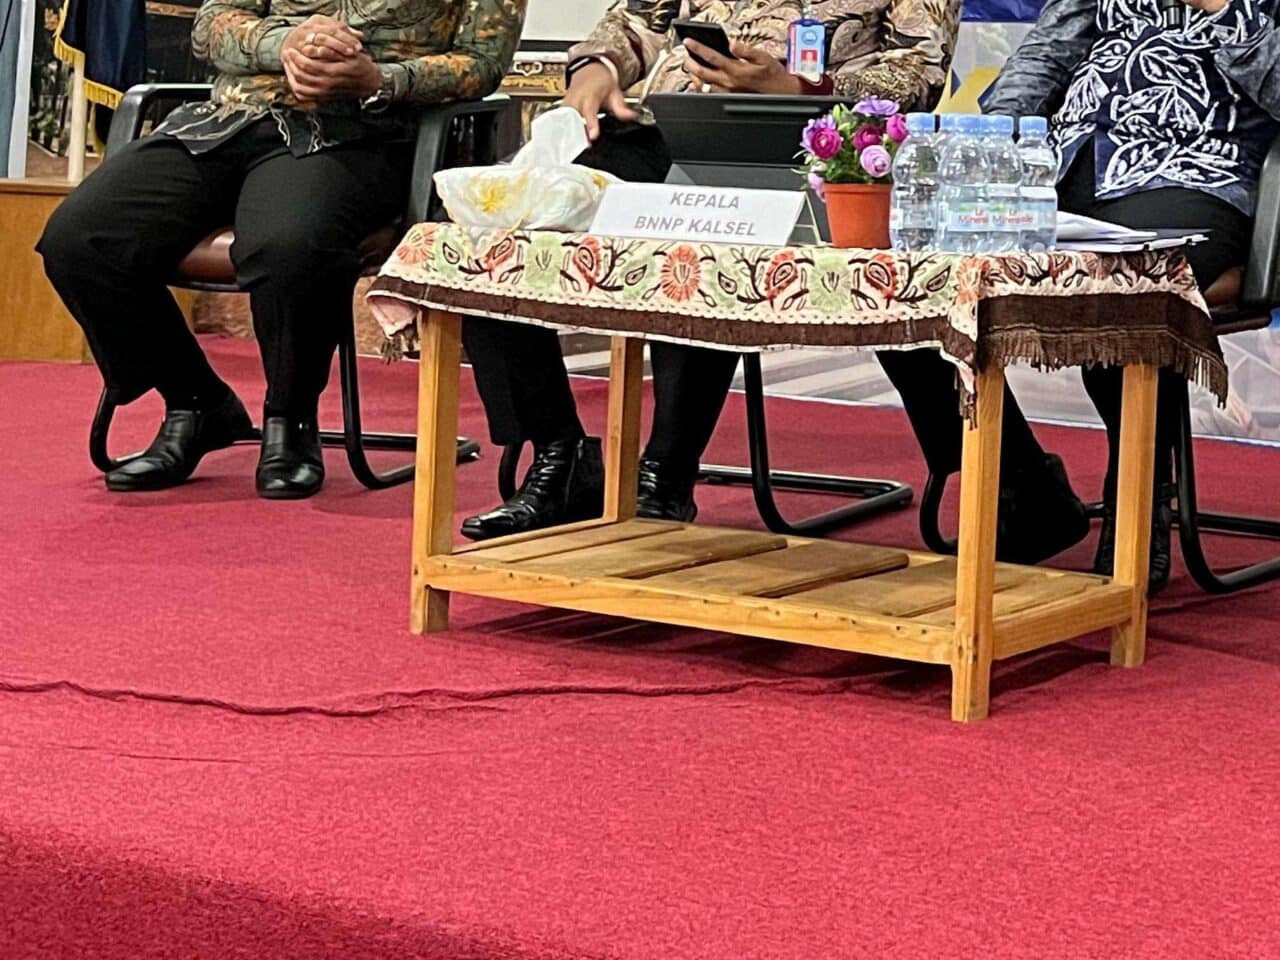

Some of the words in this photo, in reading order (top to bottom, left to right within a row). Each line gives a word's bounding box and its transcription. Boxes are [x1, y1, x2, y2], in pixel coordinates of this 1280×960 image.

[670, 192, 740, 209] KEPALA
[634, 215, 685, 231] BNNP
[687, 219, 757, 236] KALSEL
